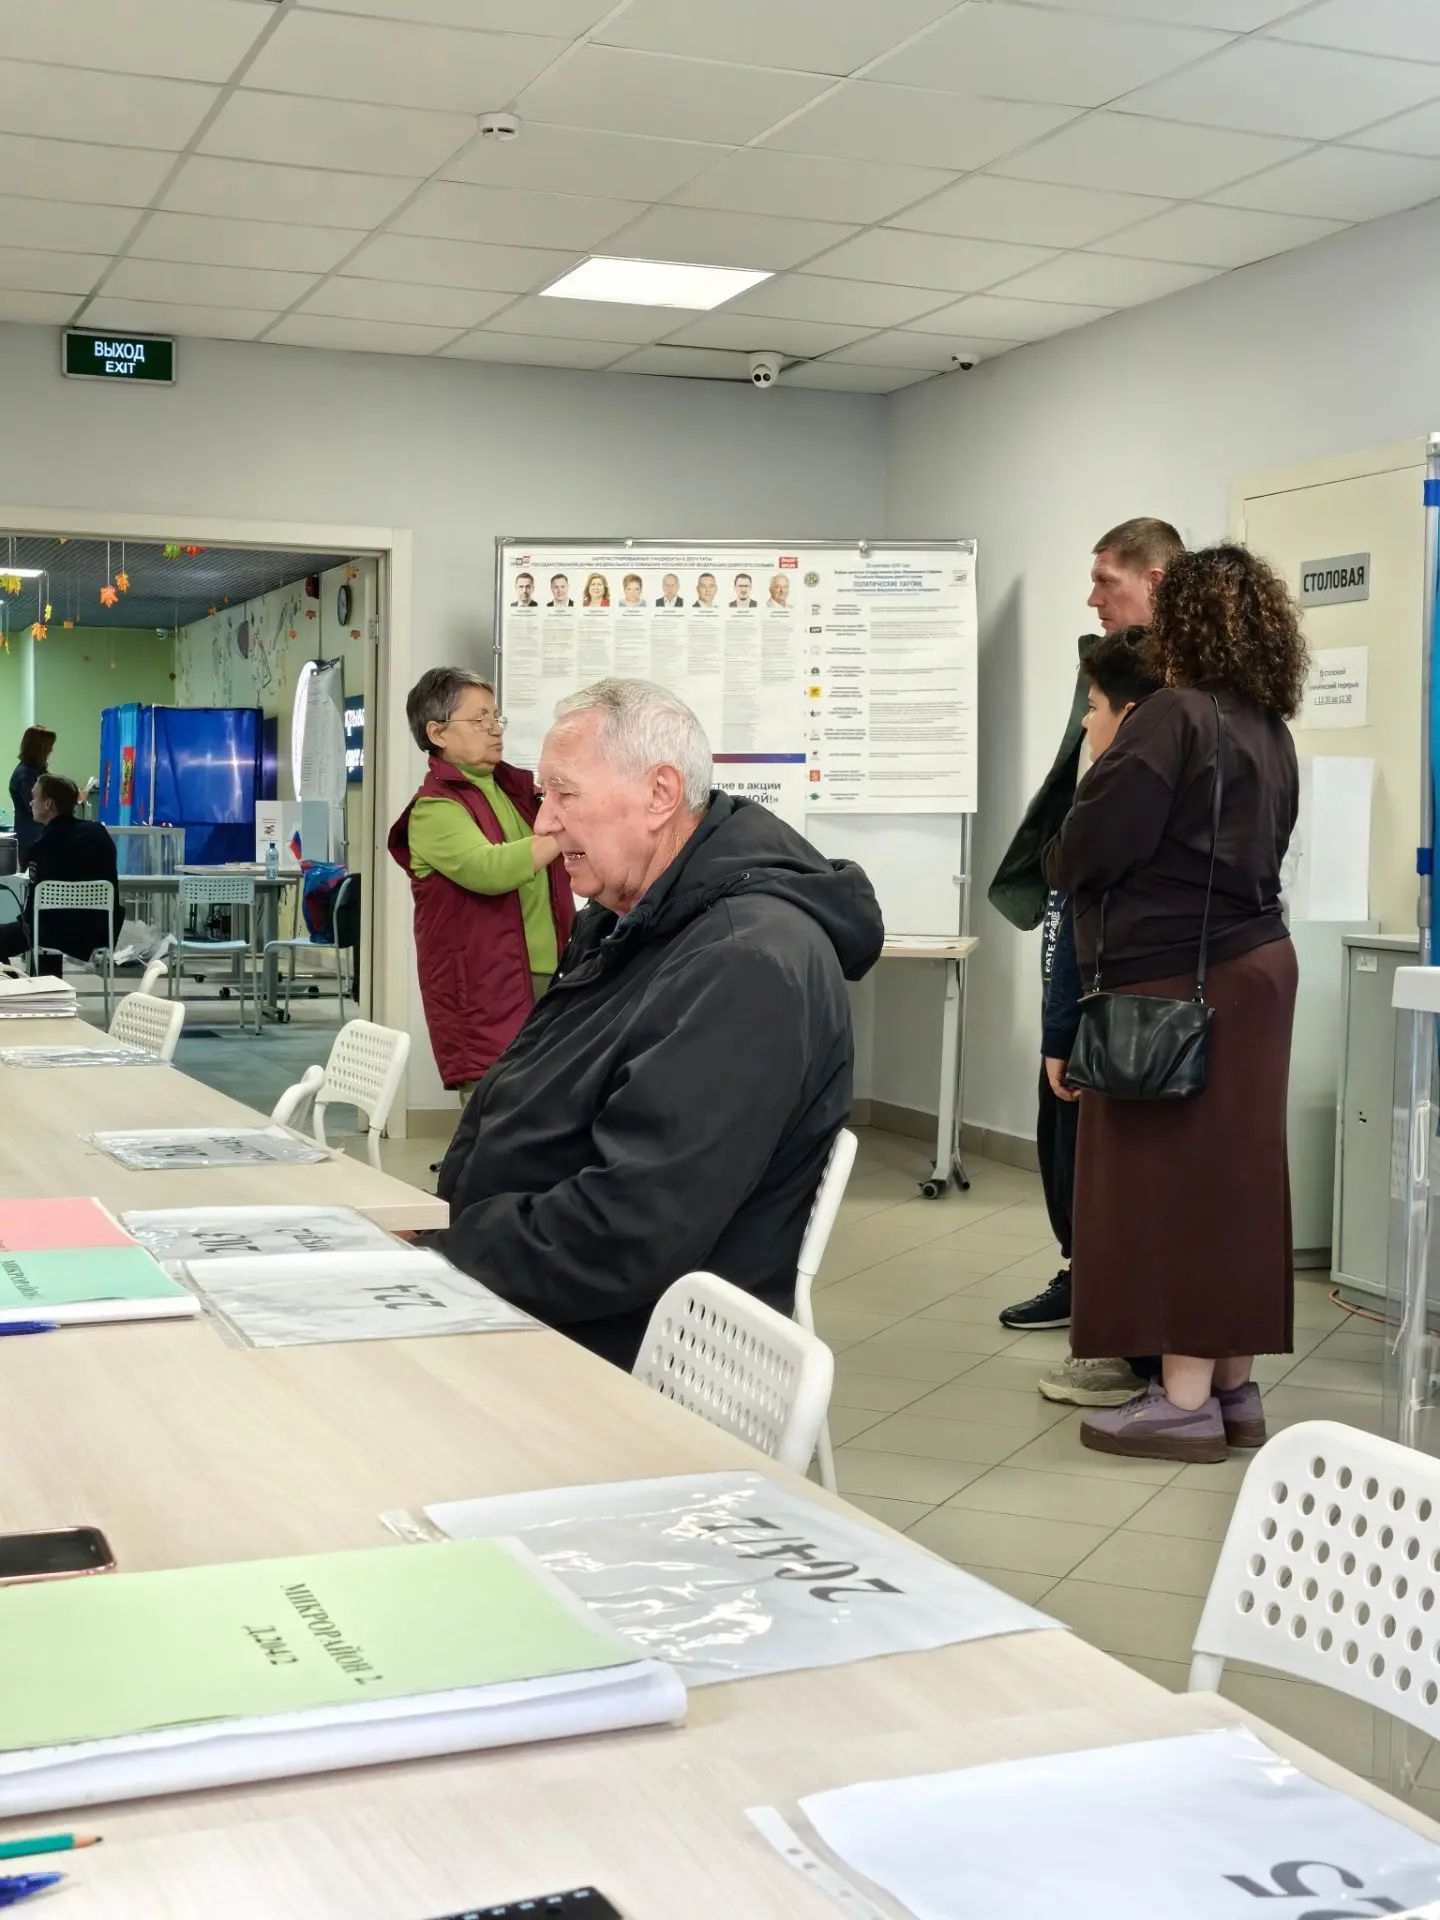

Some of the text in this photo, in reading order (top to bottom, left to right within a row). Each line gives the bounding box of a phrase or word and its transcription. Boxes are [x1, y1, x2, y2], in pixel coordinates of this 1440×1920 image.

[94, 340, 145, 362] ВЫХОД
[105, 361, 136, 374] EXIT
[1303, 565, 1364, 593] СТОЛОВАЯ
[738, 782, 744, 790] в
[747, 782, 781, 791] акции
[191, 1233, 262, 1252] 203
[361, 1284, 448, 1310] 224
[697, 1516, 905, 1603] 204/2
[280, 1582, 385, 1685] МИКРОРАЙОН 2
